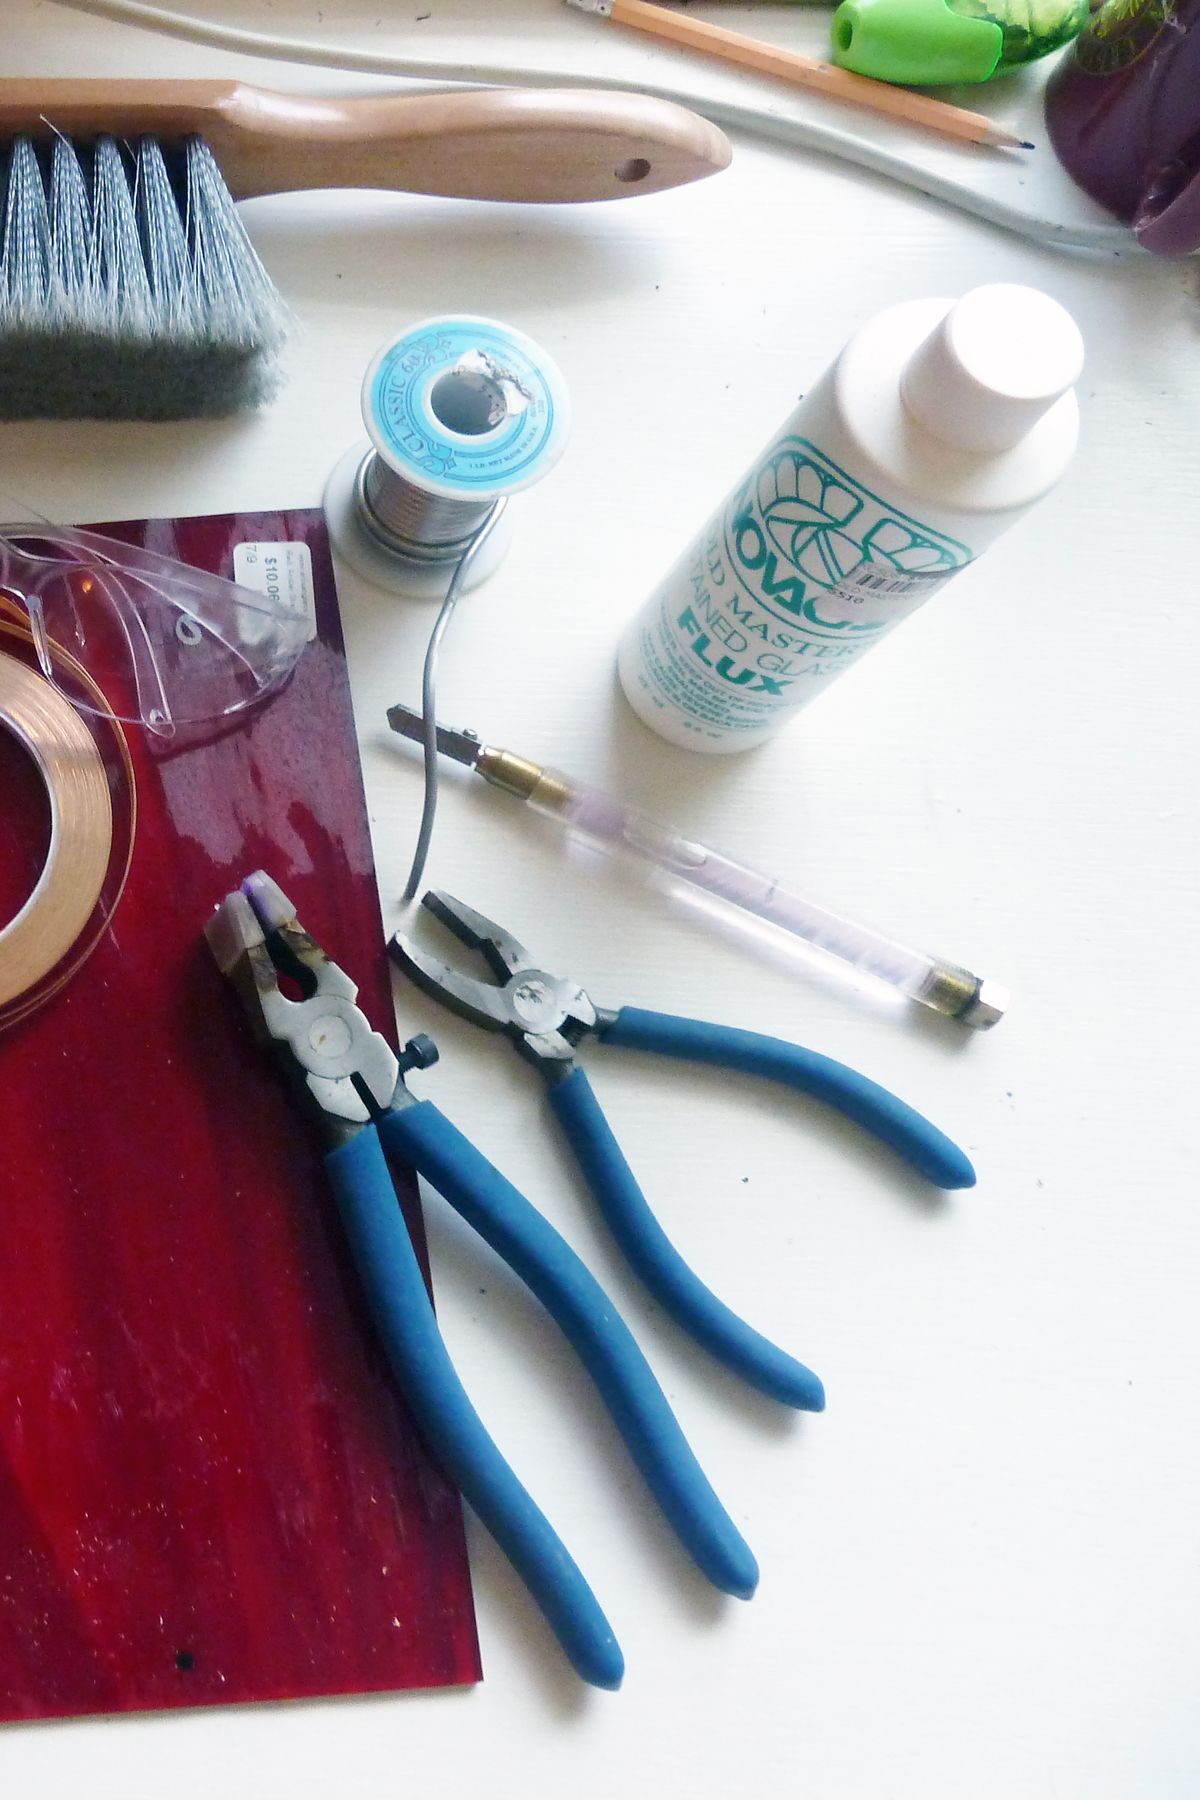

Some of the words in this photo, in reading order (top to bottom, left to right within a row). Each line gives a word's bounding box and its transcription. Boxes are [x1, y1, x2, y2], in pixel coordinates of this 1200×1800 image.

[388, 376, 424, 452] CLASSIC
[677, 605, 794, 697] FLUX
[703, 680, 727, 697] OUT
